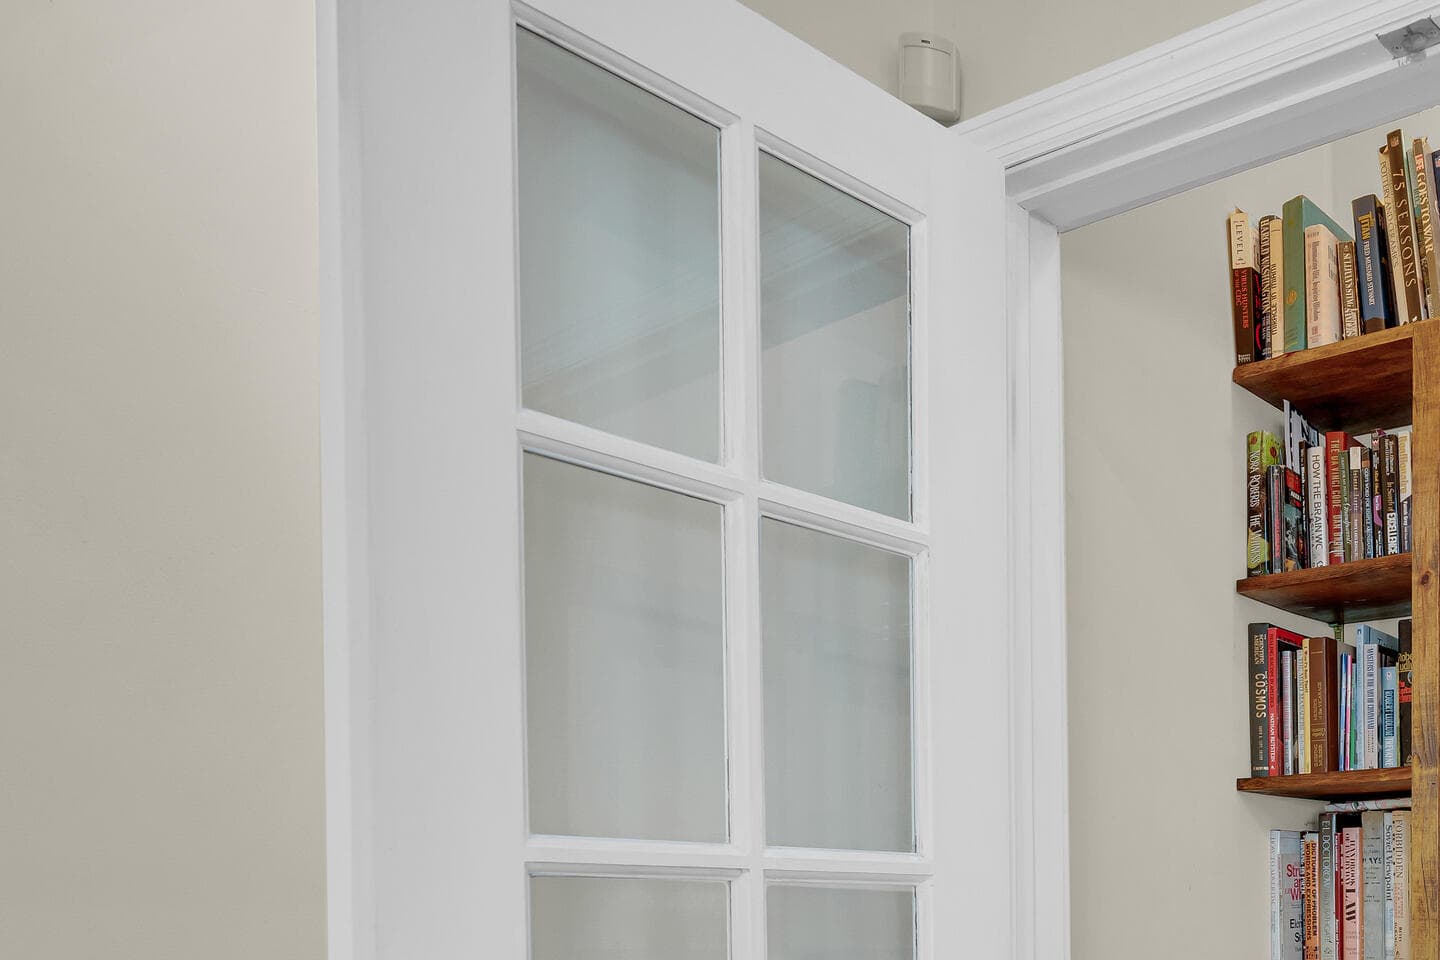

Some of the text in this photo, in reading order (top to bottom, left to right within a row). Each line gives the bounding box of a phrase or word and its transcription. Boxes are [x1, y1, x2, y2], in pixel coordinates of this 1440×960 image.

[1397, 199, 1416, 288] SEASONS
[1312, 454, 1322, 531] HOW THE BRAIN
[1256, 673, 1266, 718] COSMOS
[1346, 889, 1355, 922] LAW
